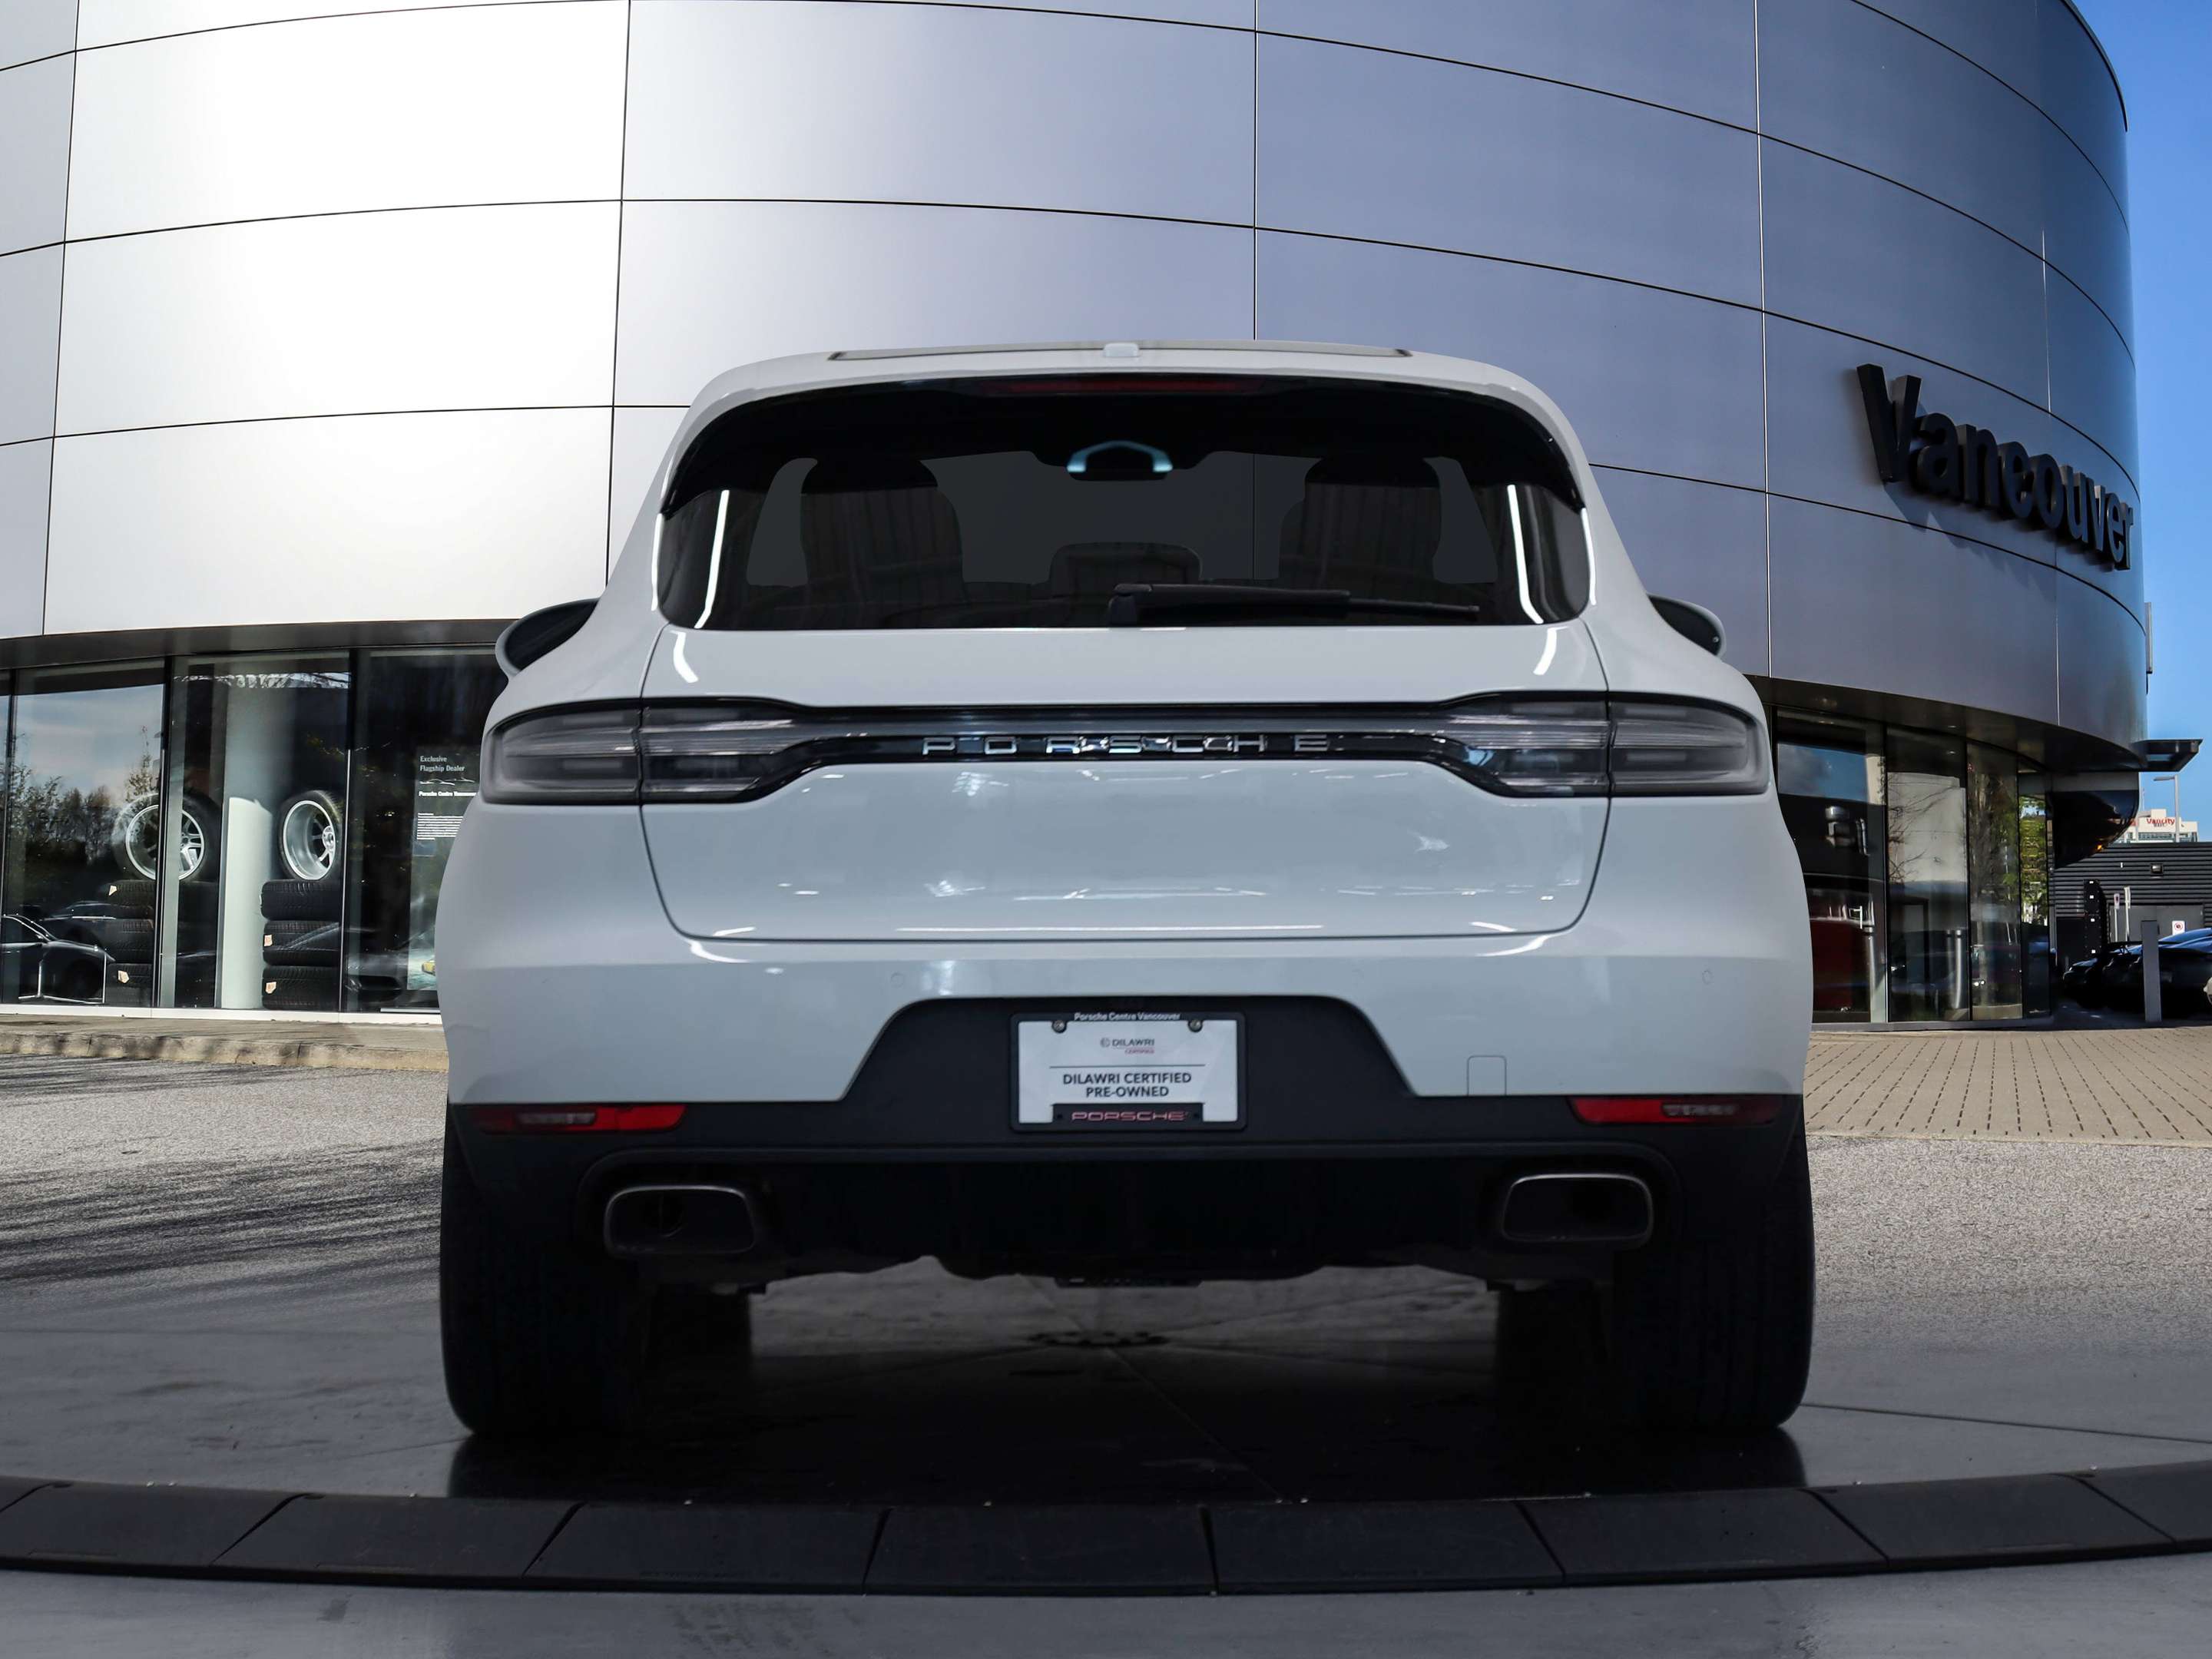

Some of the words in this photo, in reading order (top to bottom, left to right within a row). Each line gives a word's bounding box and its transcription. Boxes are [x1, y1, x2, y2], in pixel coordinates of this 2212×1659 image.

[1855, 363, 2134, 571] Vancouver
[922, 736, 1328, 756] PORSCHE
[1075, 1012, 1108, 1021] Porsche
[1109, 1012, 1136, 1021] Centre
[1137, 1012, 1181, 1020] Vancouver
[1112, 1038, 1155, 1047] DILAWRI
[1063, 1074, 1121, 1084] DILAWRI
[1124, 1073, 1192, 1084] CERTIFIED
[1086, 1087, 1169, 1098] PRE-OWNED
[1071, 1111, 1185, 1121] PORSCHE
